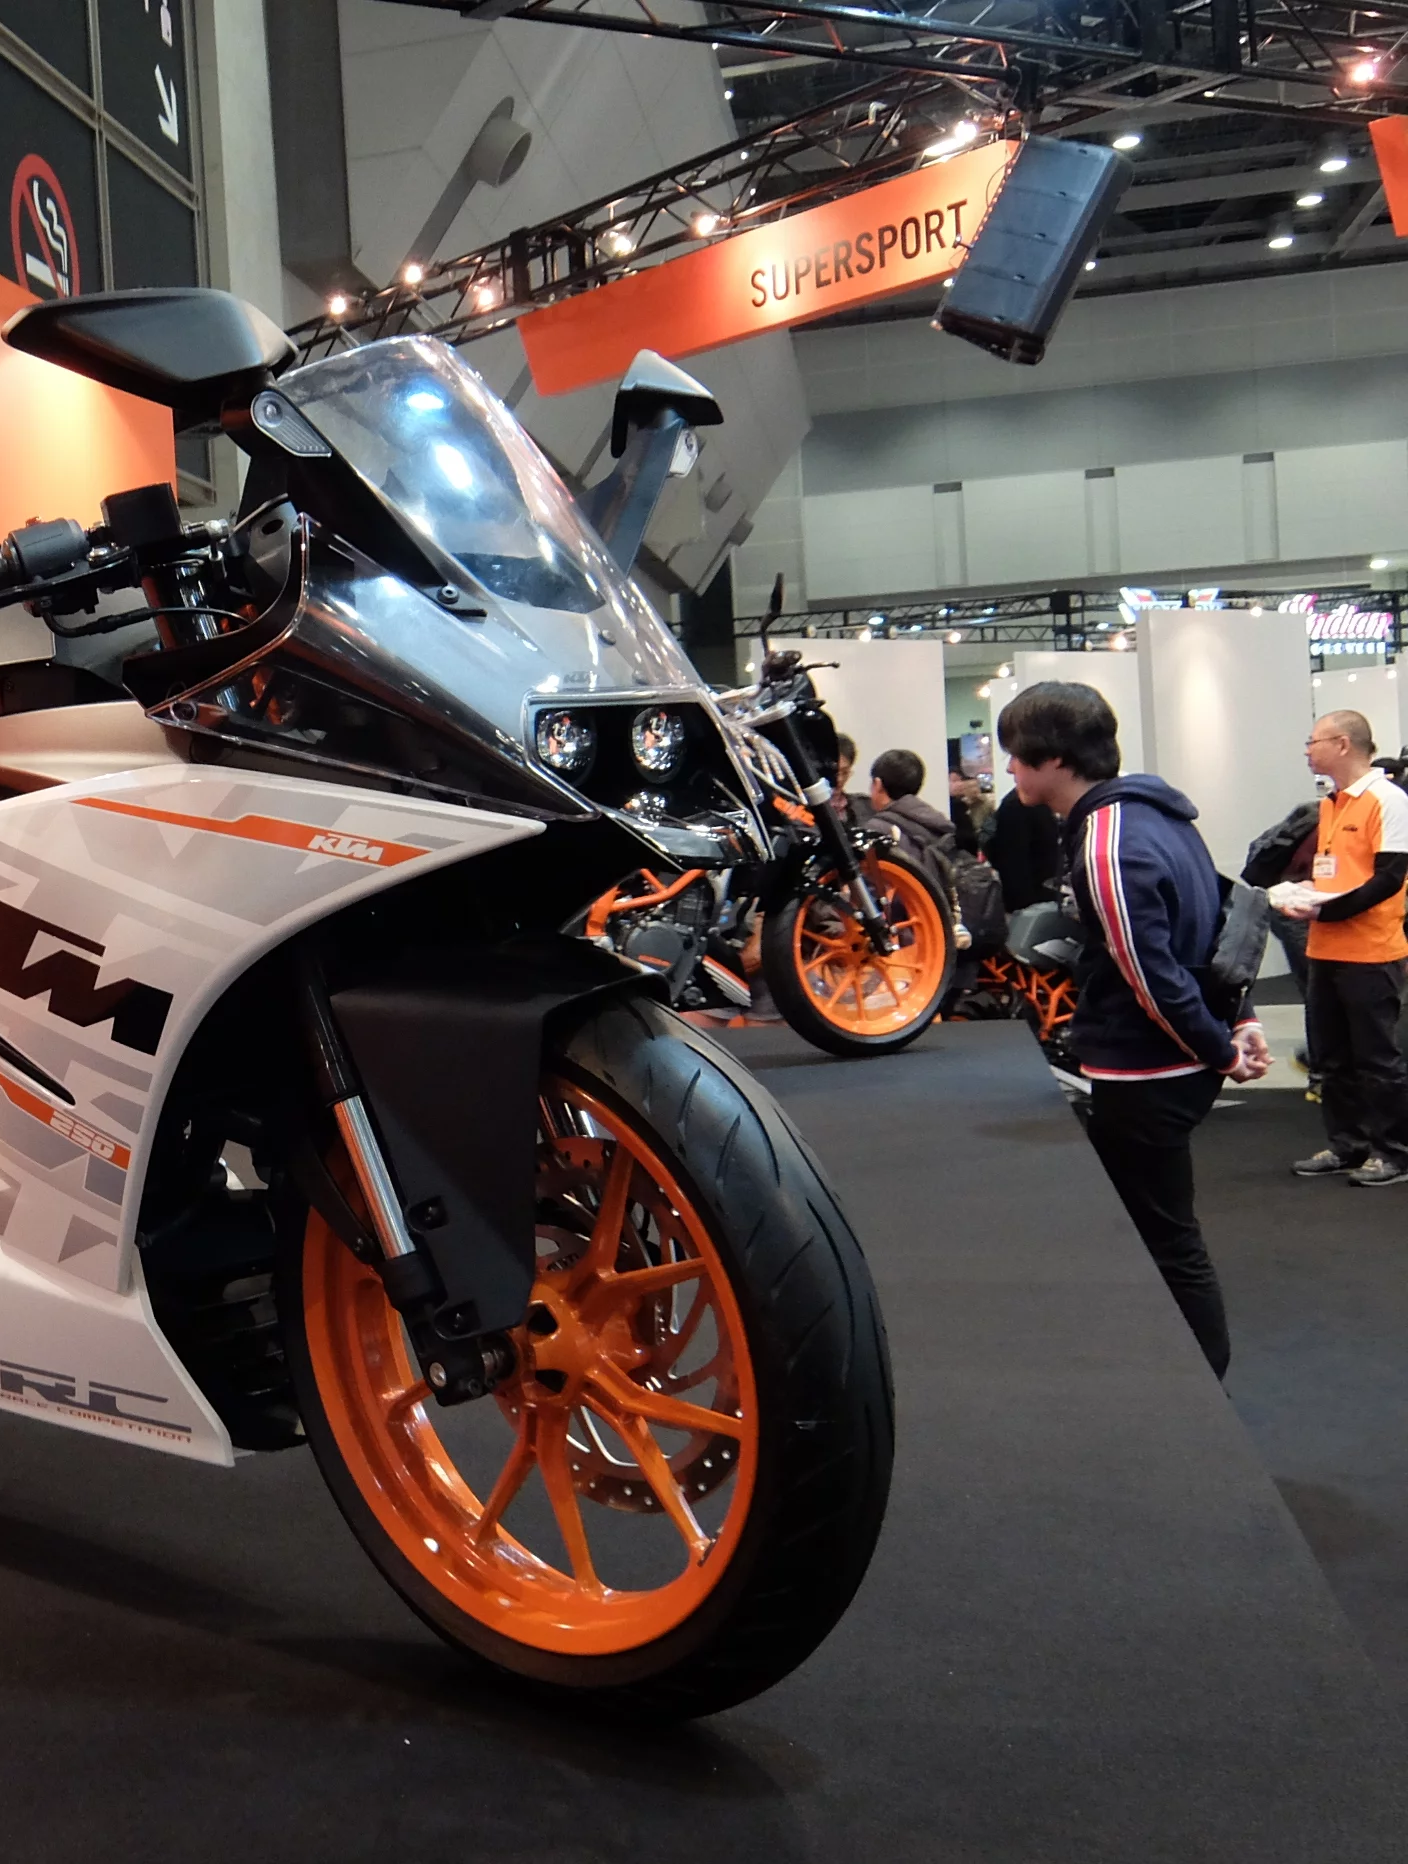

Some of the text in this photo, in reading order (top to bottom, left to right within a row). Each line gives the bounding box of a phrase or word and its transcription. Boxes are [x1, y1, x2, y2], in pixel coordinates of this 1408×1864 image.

[751, 199, 967, 308] SUPERSPORT
[308, 833, 384, 862] KTM
[49, 1110, 116, 1159] 250
[56, 1402, 192, 1443] COMPETITION
